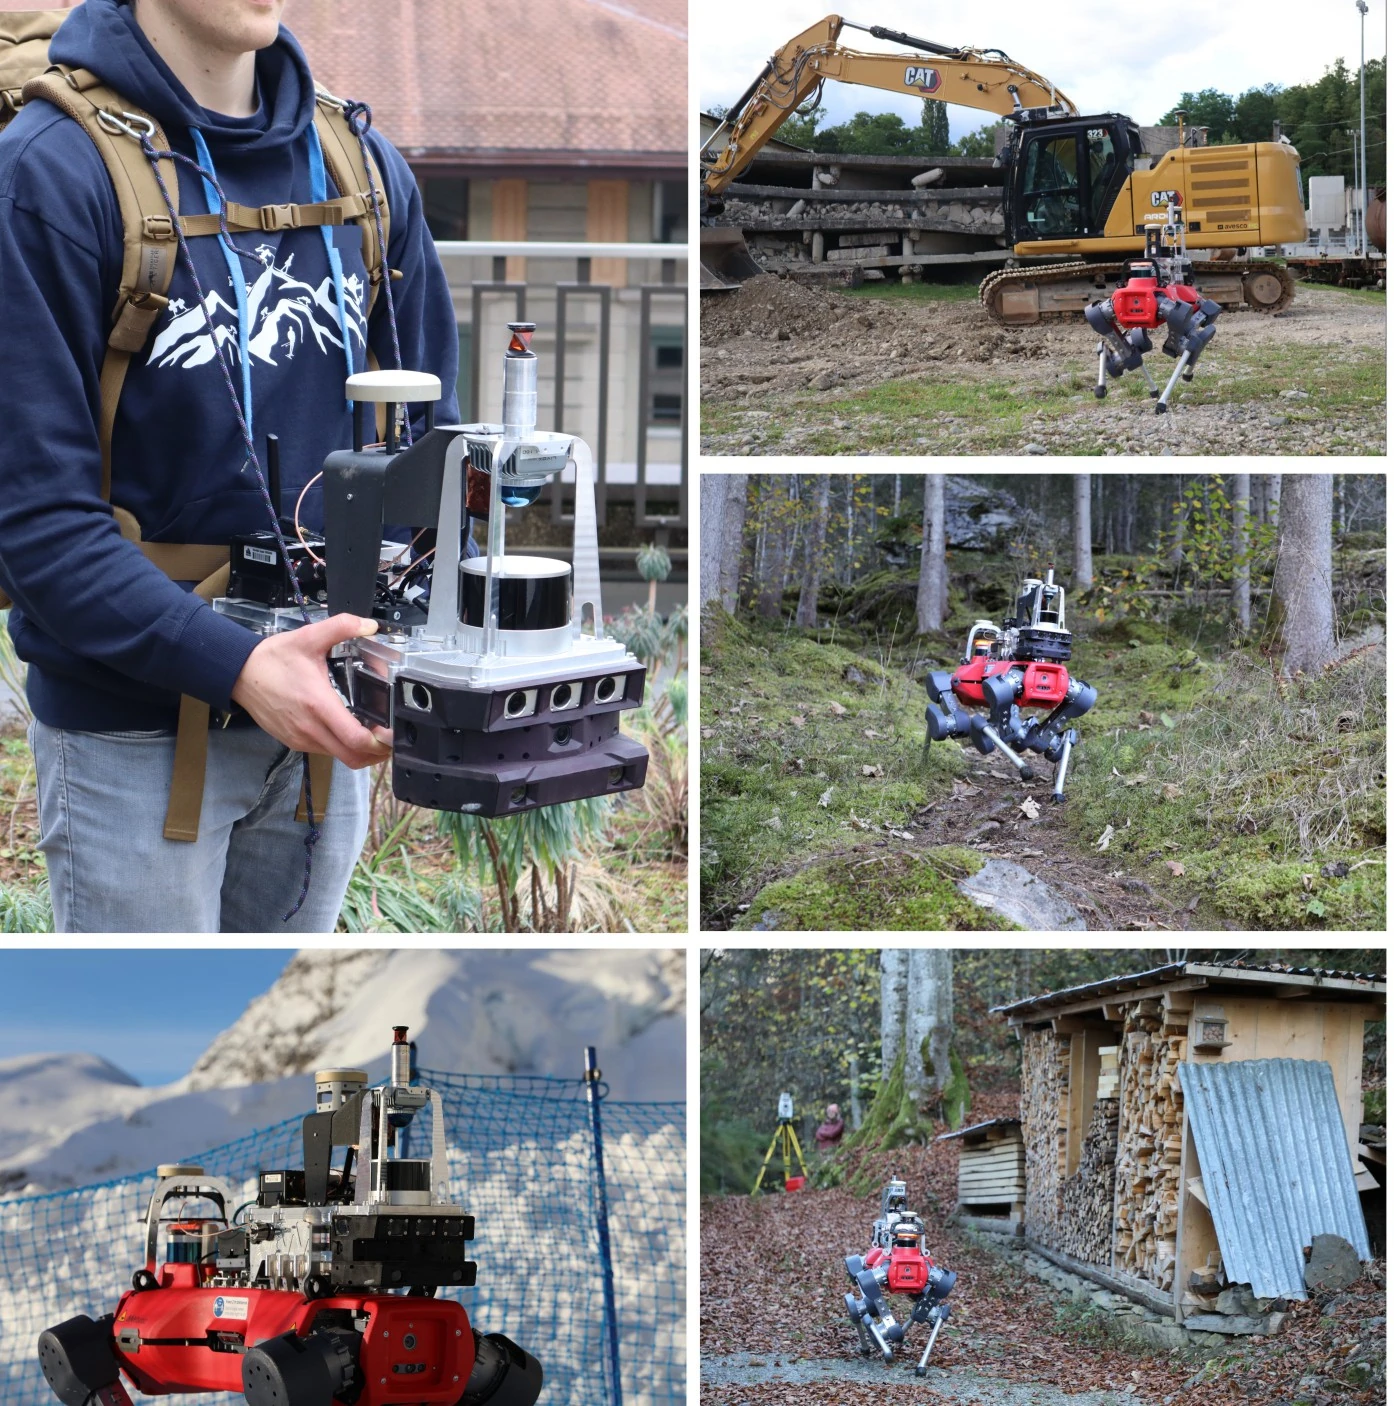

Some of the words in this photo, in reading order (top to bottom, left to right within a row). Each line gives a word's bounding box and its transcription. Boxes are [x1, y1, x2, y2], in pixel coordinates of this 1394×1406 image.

[905, 66, 934, 88] CAT
[1087, 129, 1103, 138] 323
[1151, 190, 1176, 207] CAT
